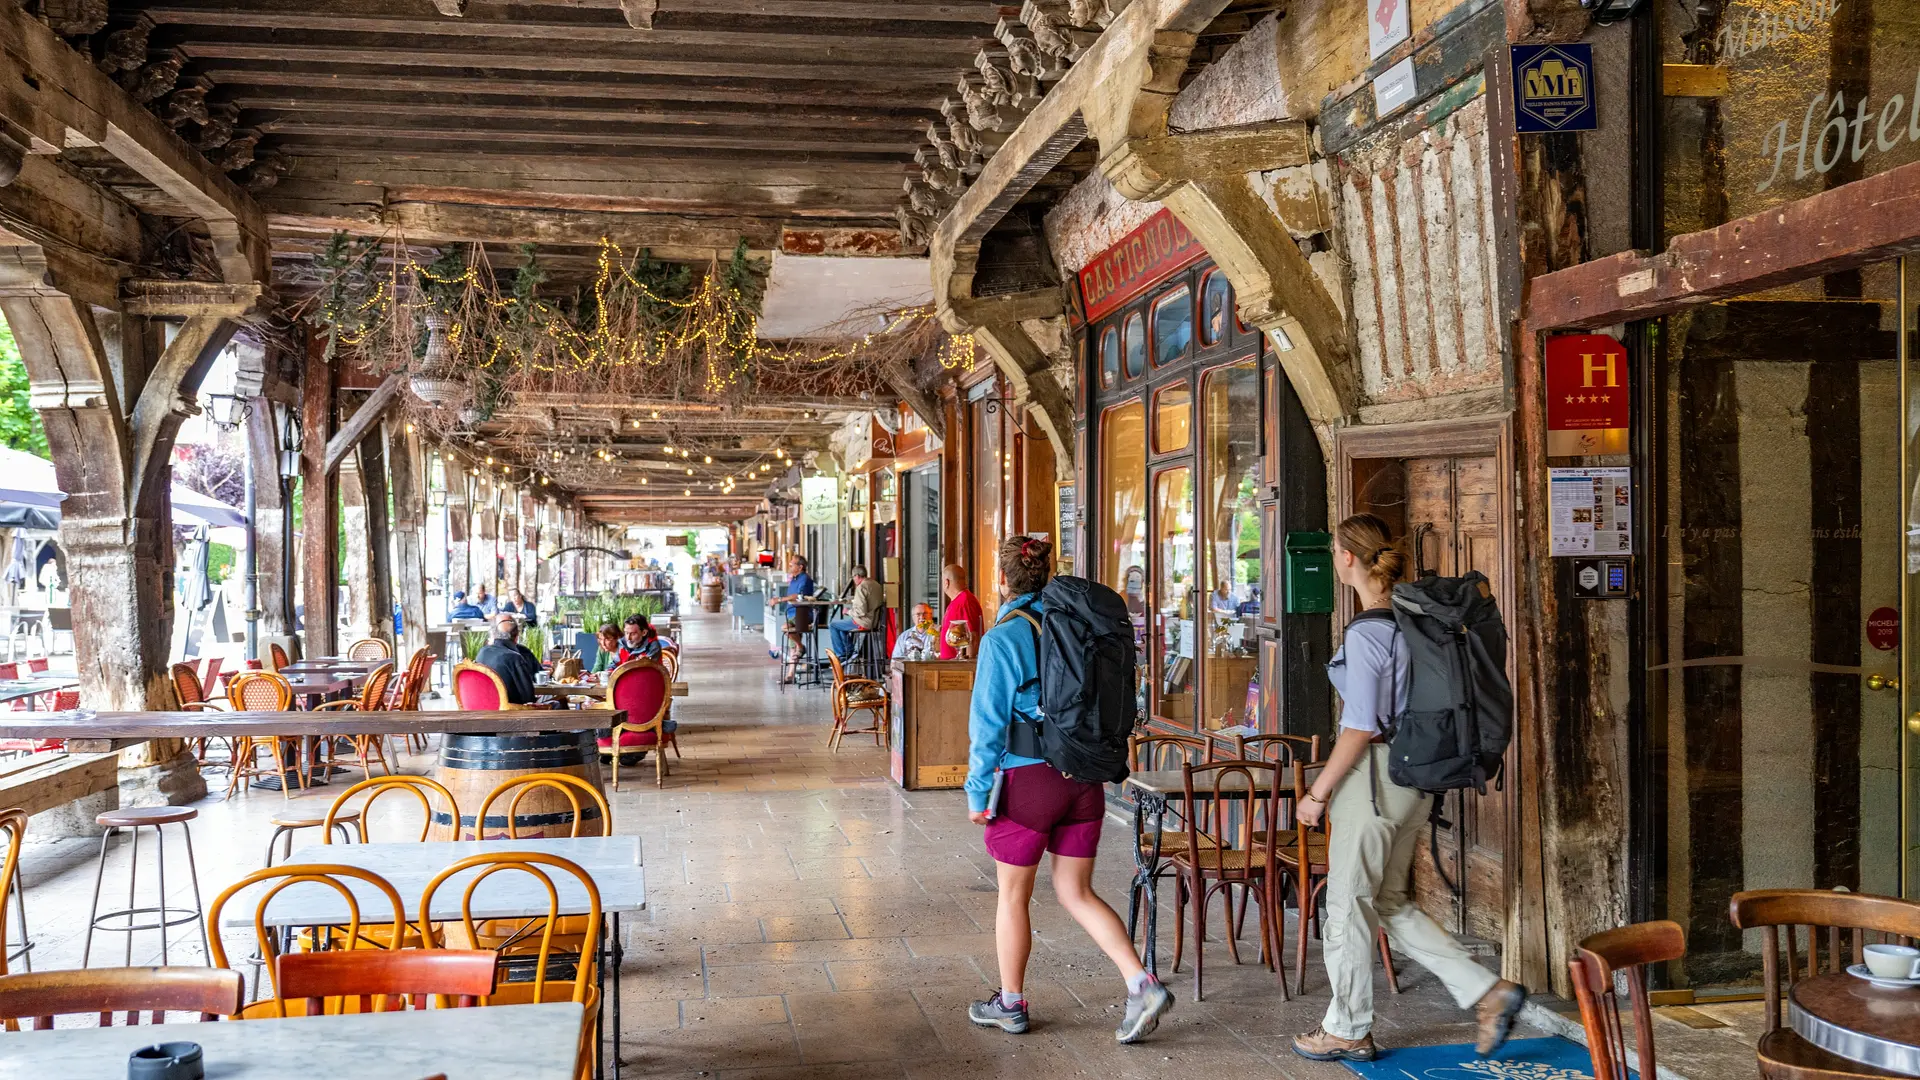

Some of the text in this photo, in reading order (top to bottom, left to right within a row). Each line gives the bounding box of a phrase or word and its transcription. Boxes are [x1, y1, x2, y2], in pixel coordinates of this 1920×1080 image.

[1714, 0, 1842, 69] Maison
[1528, 74, 1580, 97] VMF
[1084, 209, 1199, 307] CASTIGNOL
[1579, 353, 1620, 388] H
[873, 437, 893, 454] Bar
[936, 775, 967, 784] DEUT
